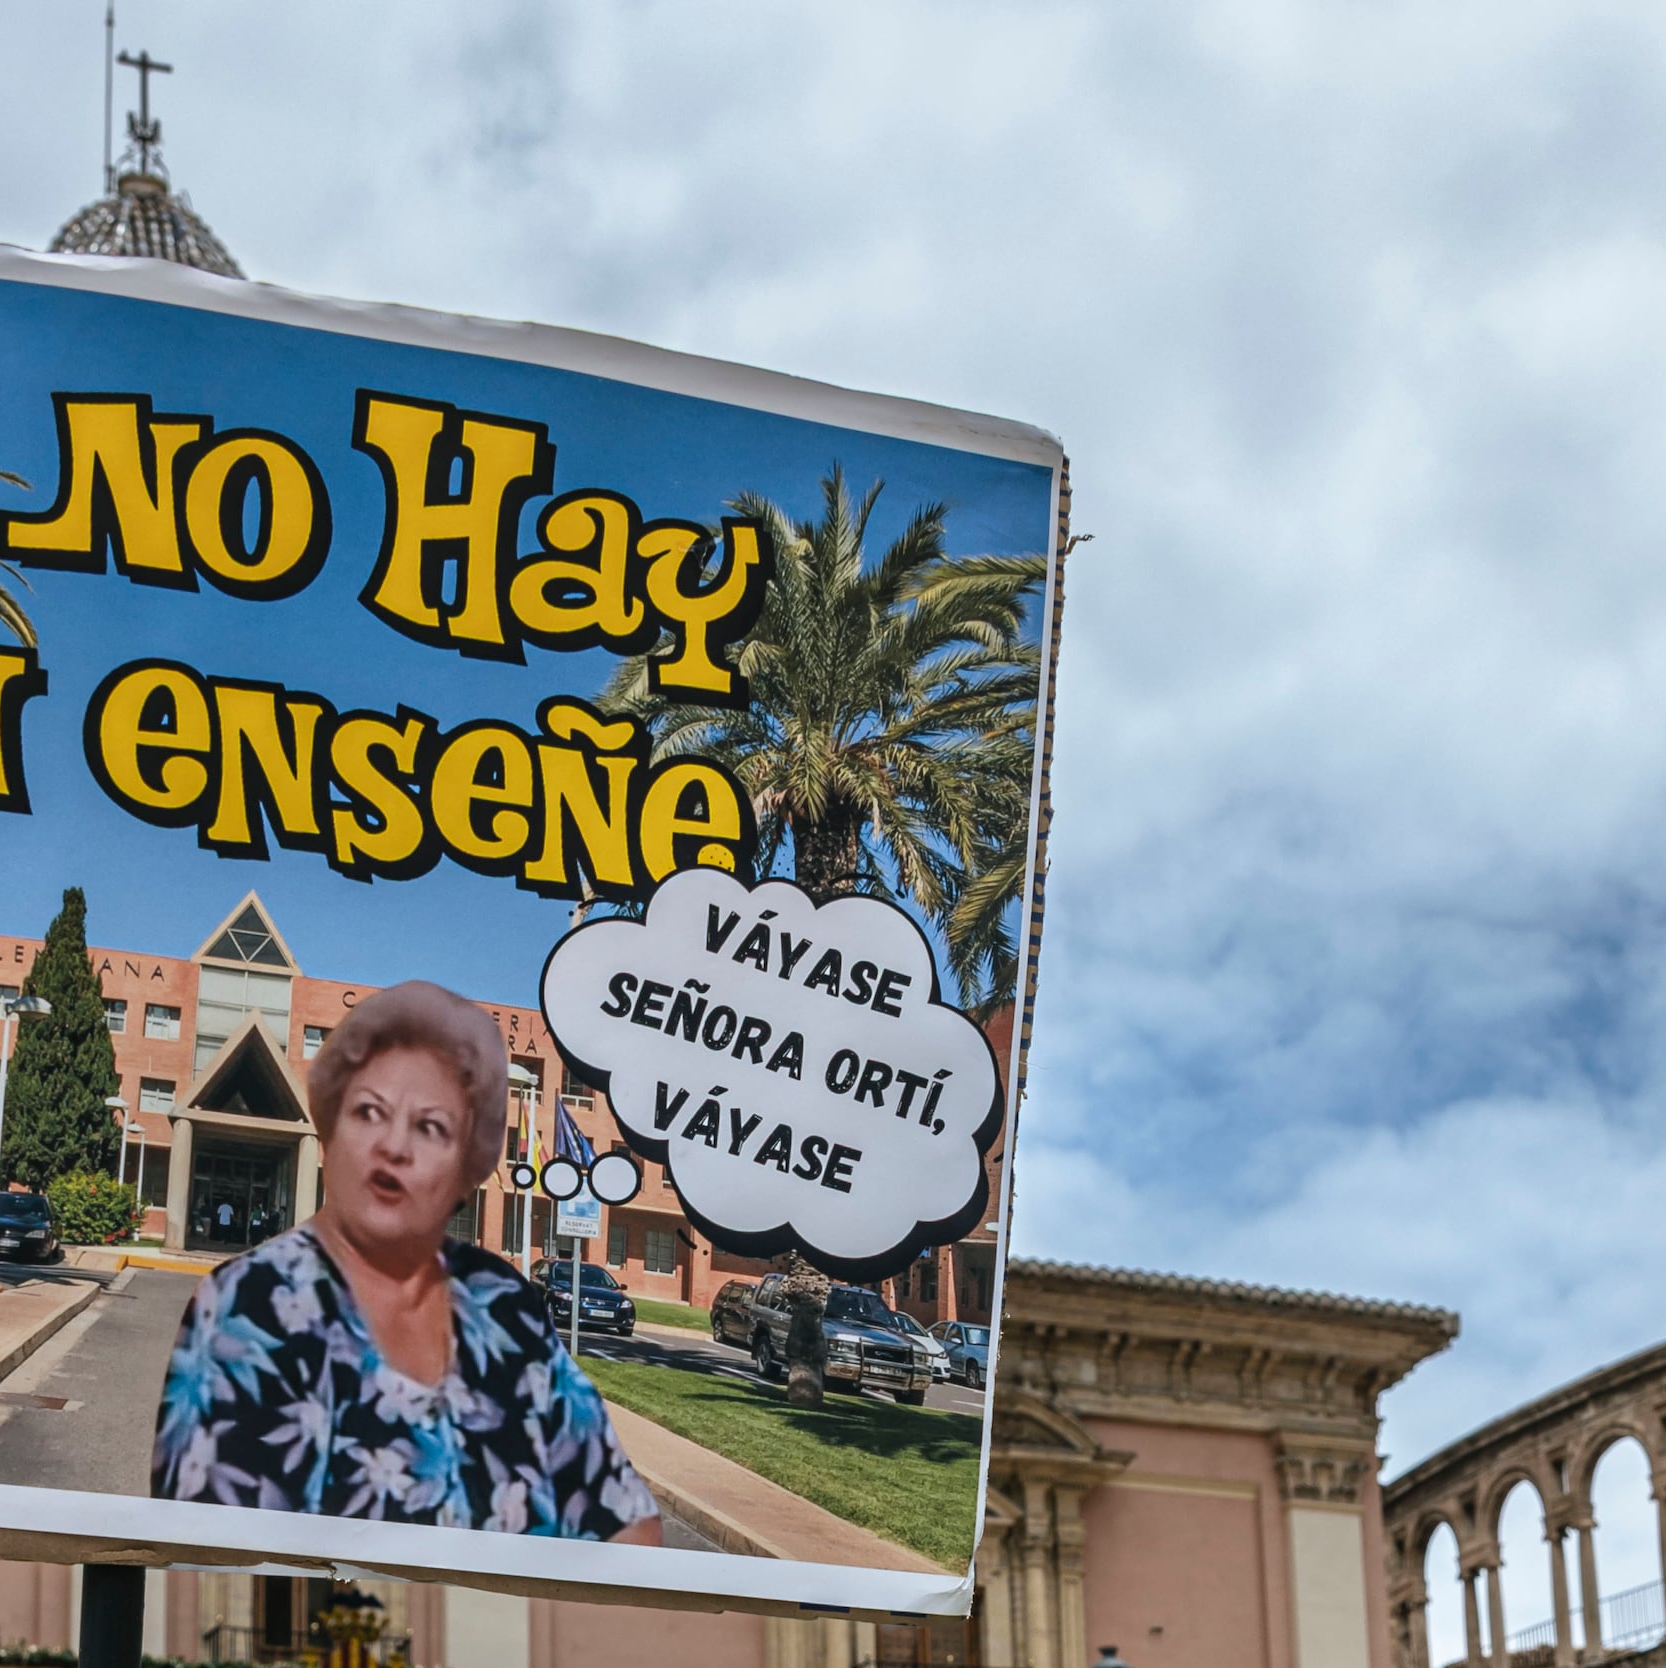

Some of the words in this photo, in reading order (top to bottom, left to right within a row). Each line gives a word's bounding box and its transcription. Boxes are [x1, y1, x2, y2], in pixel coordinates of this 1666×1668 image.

[0, 396, 325, 594] NO
[706, 903, 912, 1018] VÁYASE
[600, 972, 806, 1081] SEÑORA
[824, 1048, 954, 1137] ORTÍ,
[653, 1081, 863, 1194] VÁYASE
